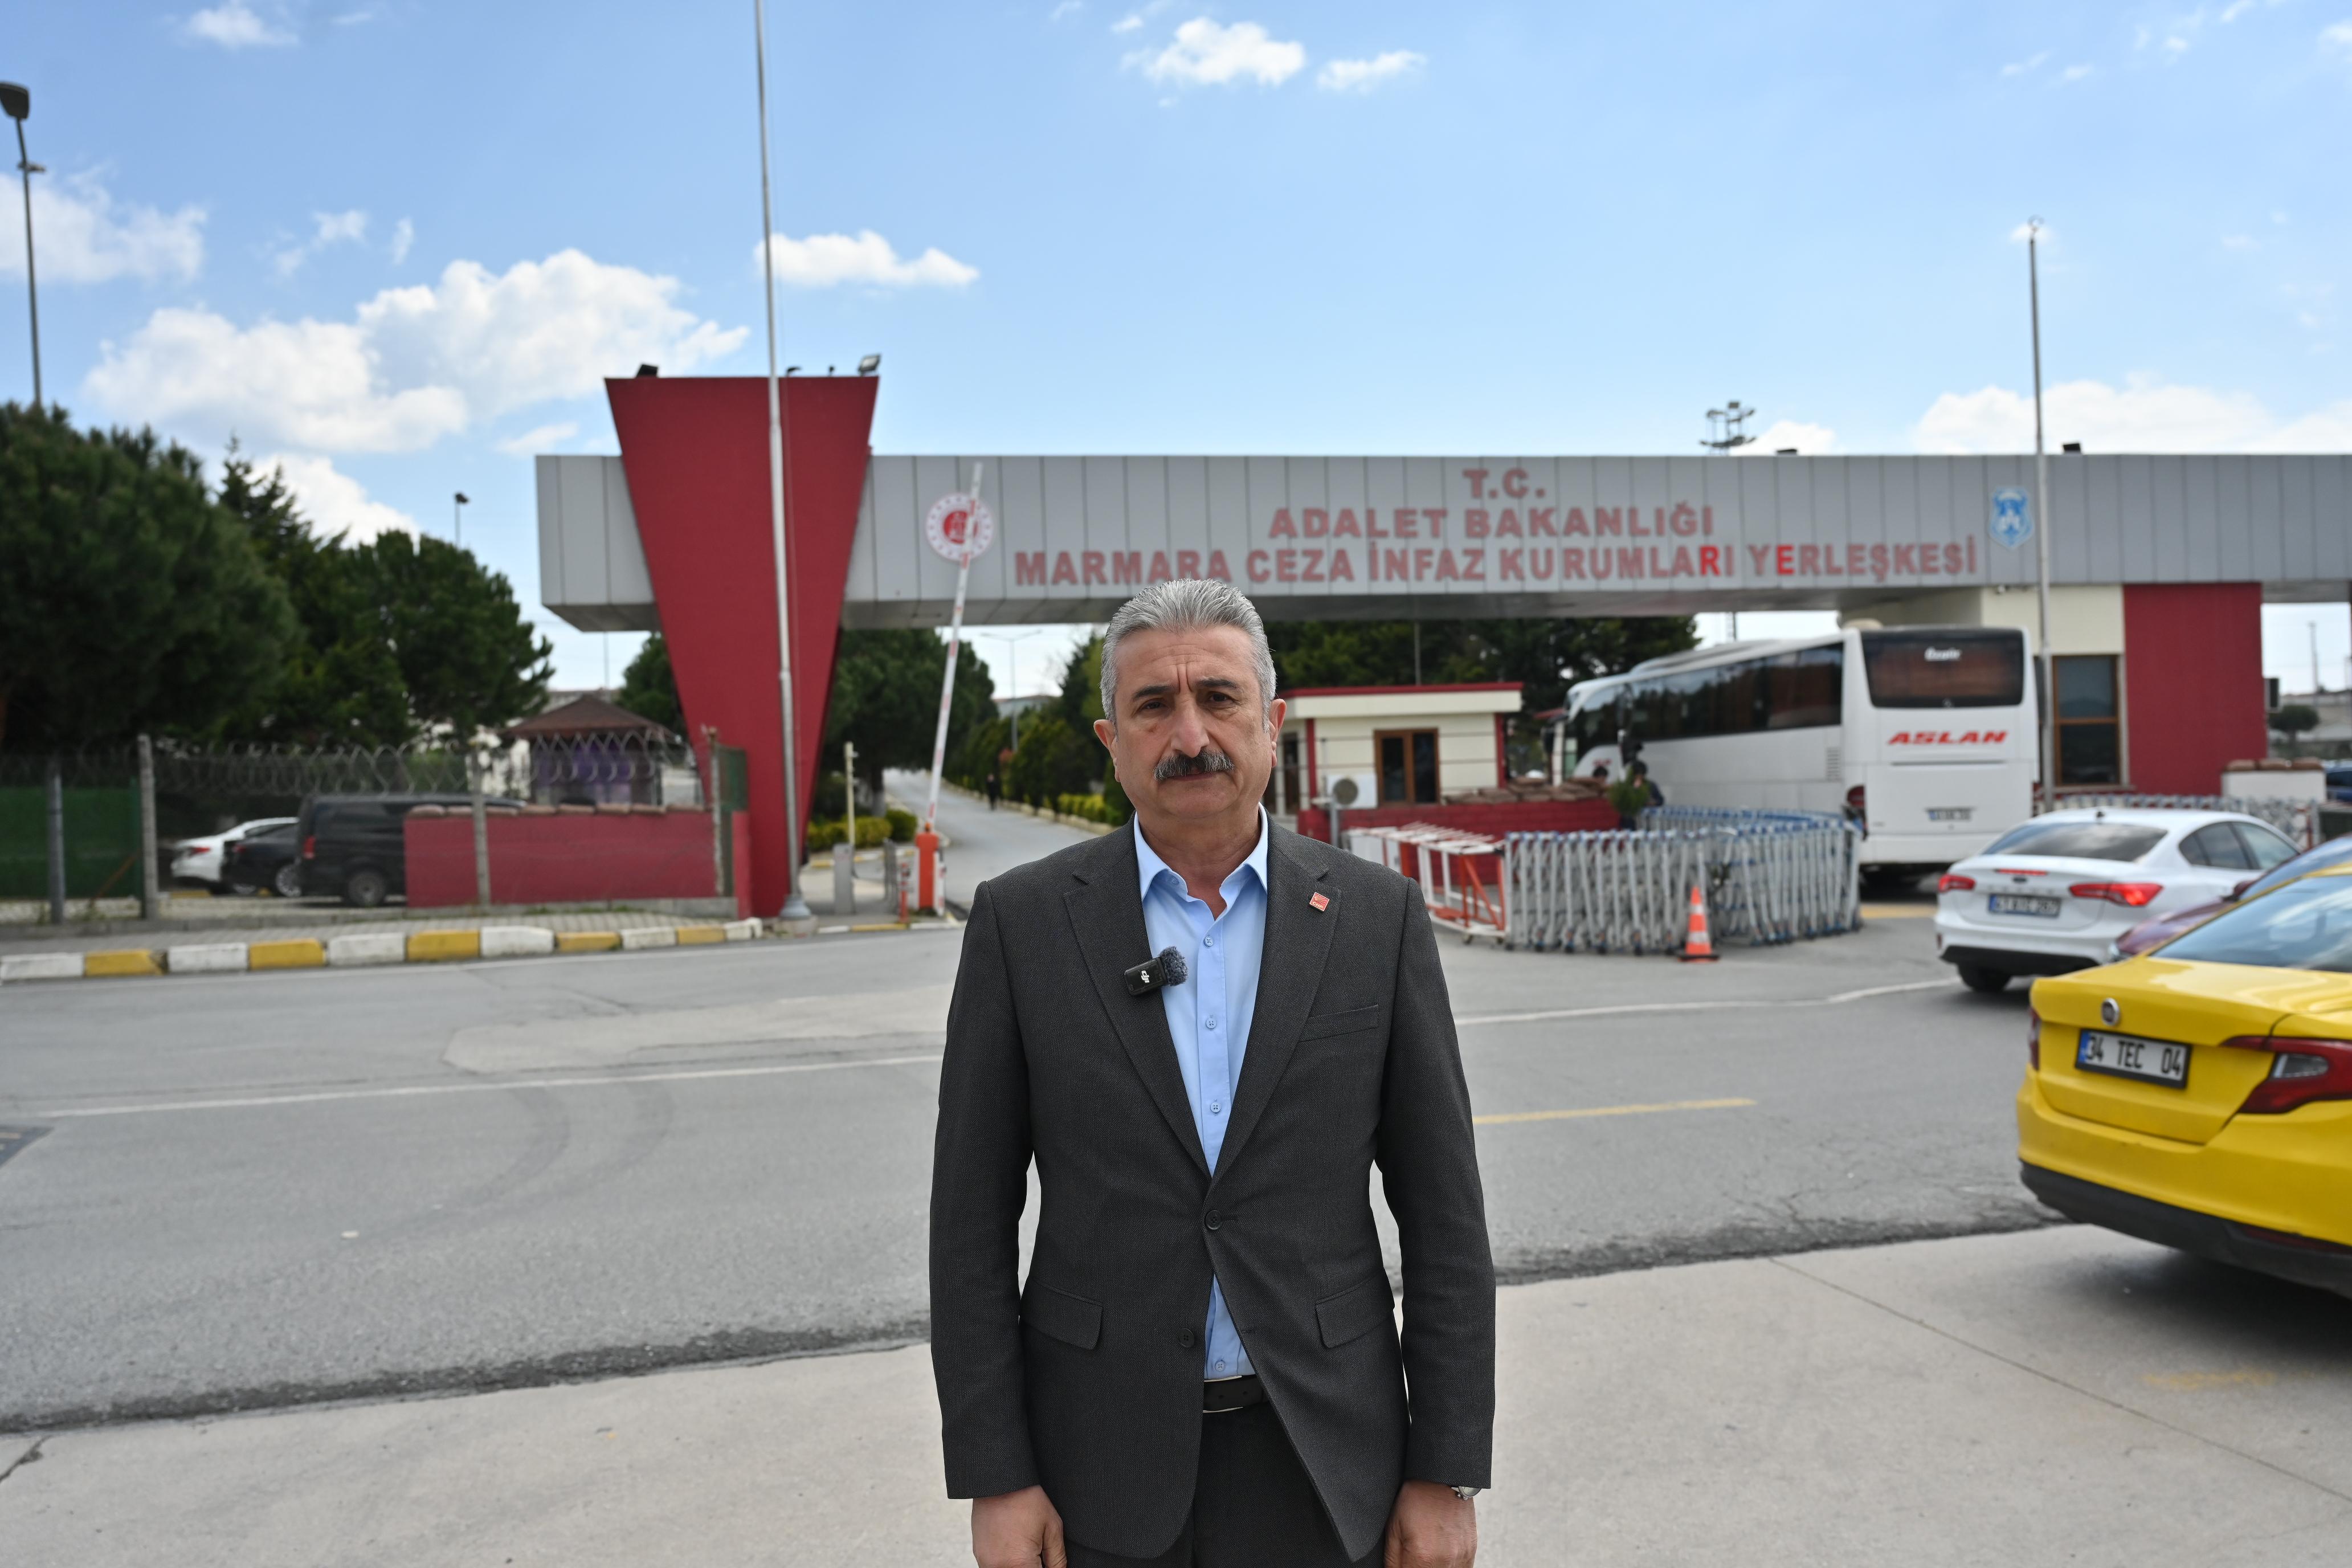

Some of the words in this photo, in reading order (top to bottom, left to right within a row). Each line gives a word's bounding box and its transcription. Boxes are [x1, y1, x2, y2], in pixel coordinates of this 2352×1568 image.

[1463, 467, 1546, 499] T.C.
[1268, 508, 1448, 539] ADALET
[1465, 500, 1714, 539] BAKANLIĞI
[1015, 550, 1233, 586] MARMARA
[1246, 548, 1355, 583] CEZA
[1369, 541, 1486, 582] İNFAZ
[1498, 544, 1736, 582] KURUMLARI
[1747, 533, 1977, 582] YERLEŞKESİ
[1888, 731, 2007, 745] ASLAN
[2086, 1035, 2104, 1062] 34
[2116, 1039, 2146, 1069] TEC
[2161, 1047, 2181, 1076] 04
